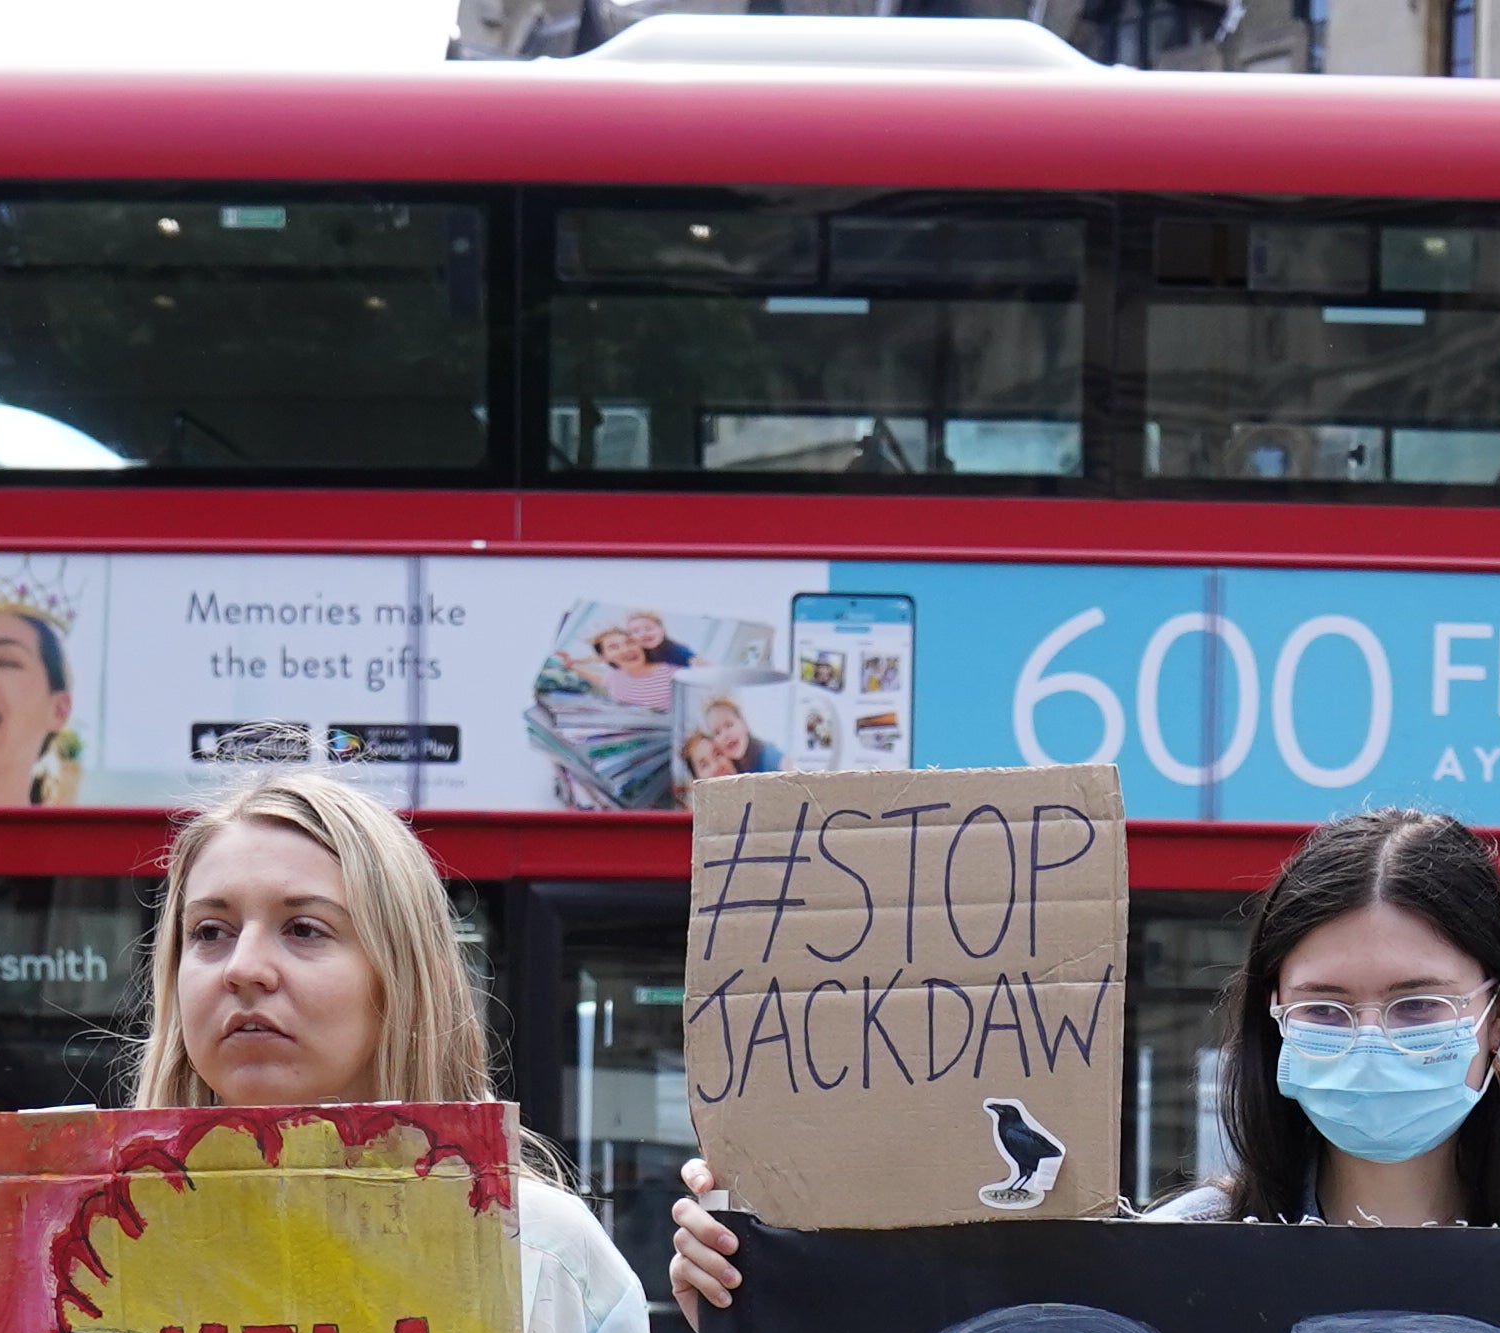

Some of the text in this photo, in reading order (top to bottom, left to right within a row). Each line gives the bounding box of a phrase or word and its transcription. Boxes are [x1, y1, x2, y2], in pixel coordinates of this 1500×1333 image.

[186, 590, 466, 627] Memories make
[210, 645, 442, 693] the best gifts
[1013, 607, 1393, 788] 600
[1432, 747, 1466, 782] A
[698, 801, 1096, 964] #STOP
[688, 963, 1114, 1103] JACKDAW
